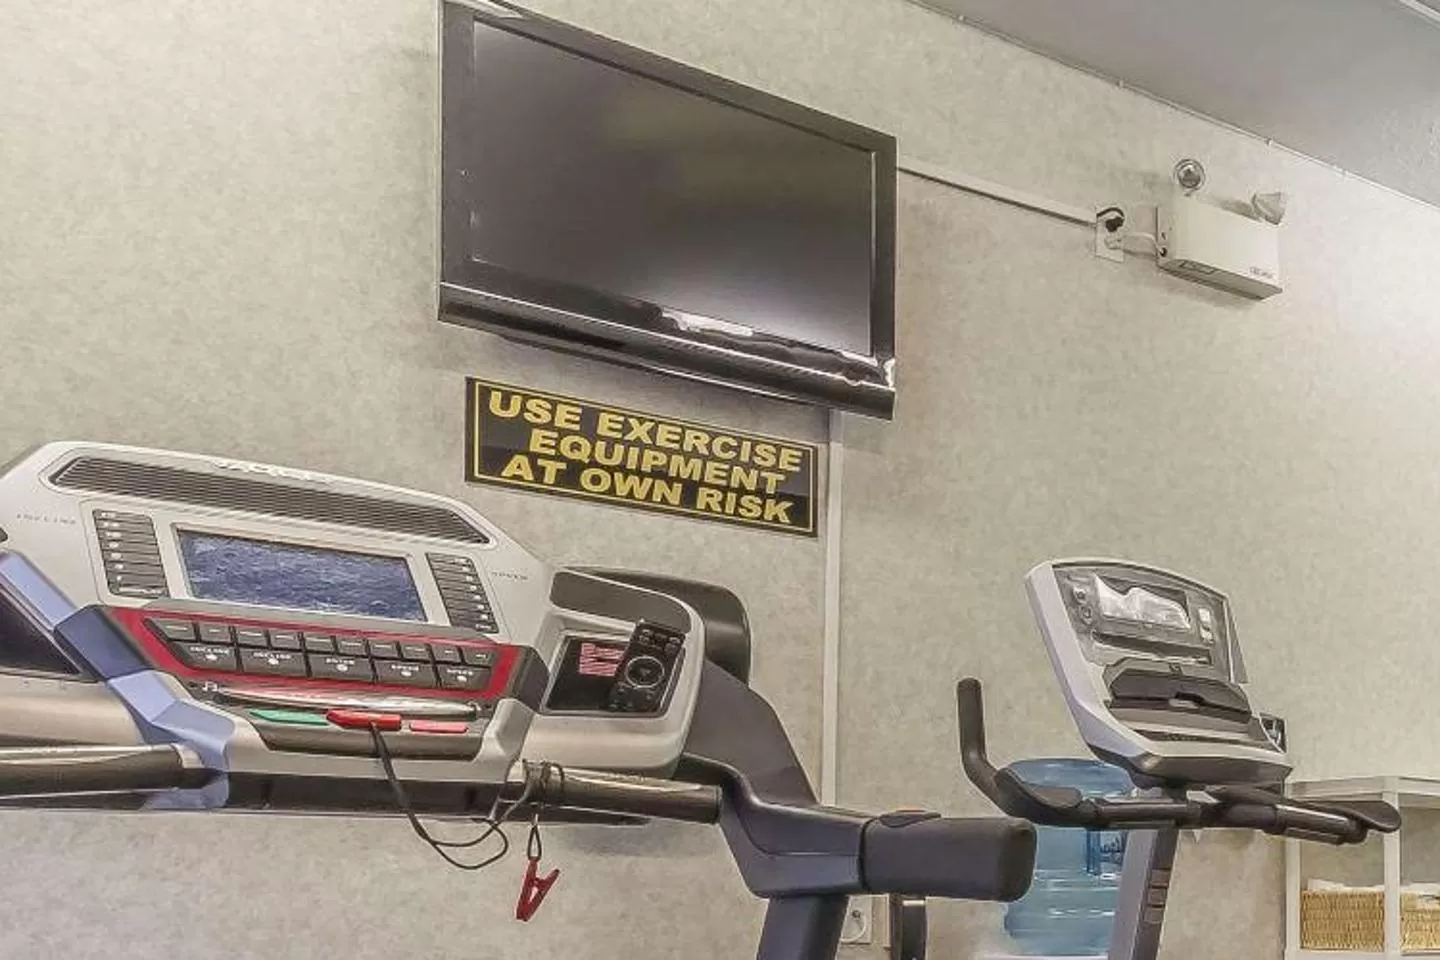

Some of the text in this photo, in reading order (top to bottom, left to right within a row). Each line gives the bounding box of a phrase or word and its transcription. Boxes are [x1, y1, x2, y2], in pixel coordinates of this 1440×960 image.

[489, 391, 803, 472] USE EXERCISE
[529, 428, 786, 495] EQUIPMENT
[501, 455, 795, 523] AT OWN RISK
